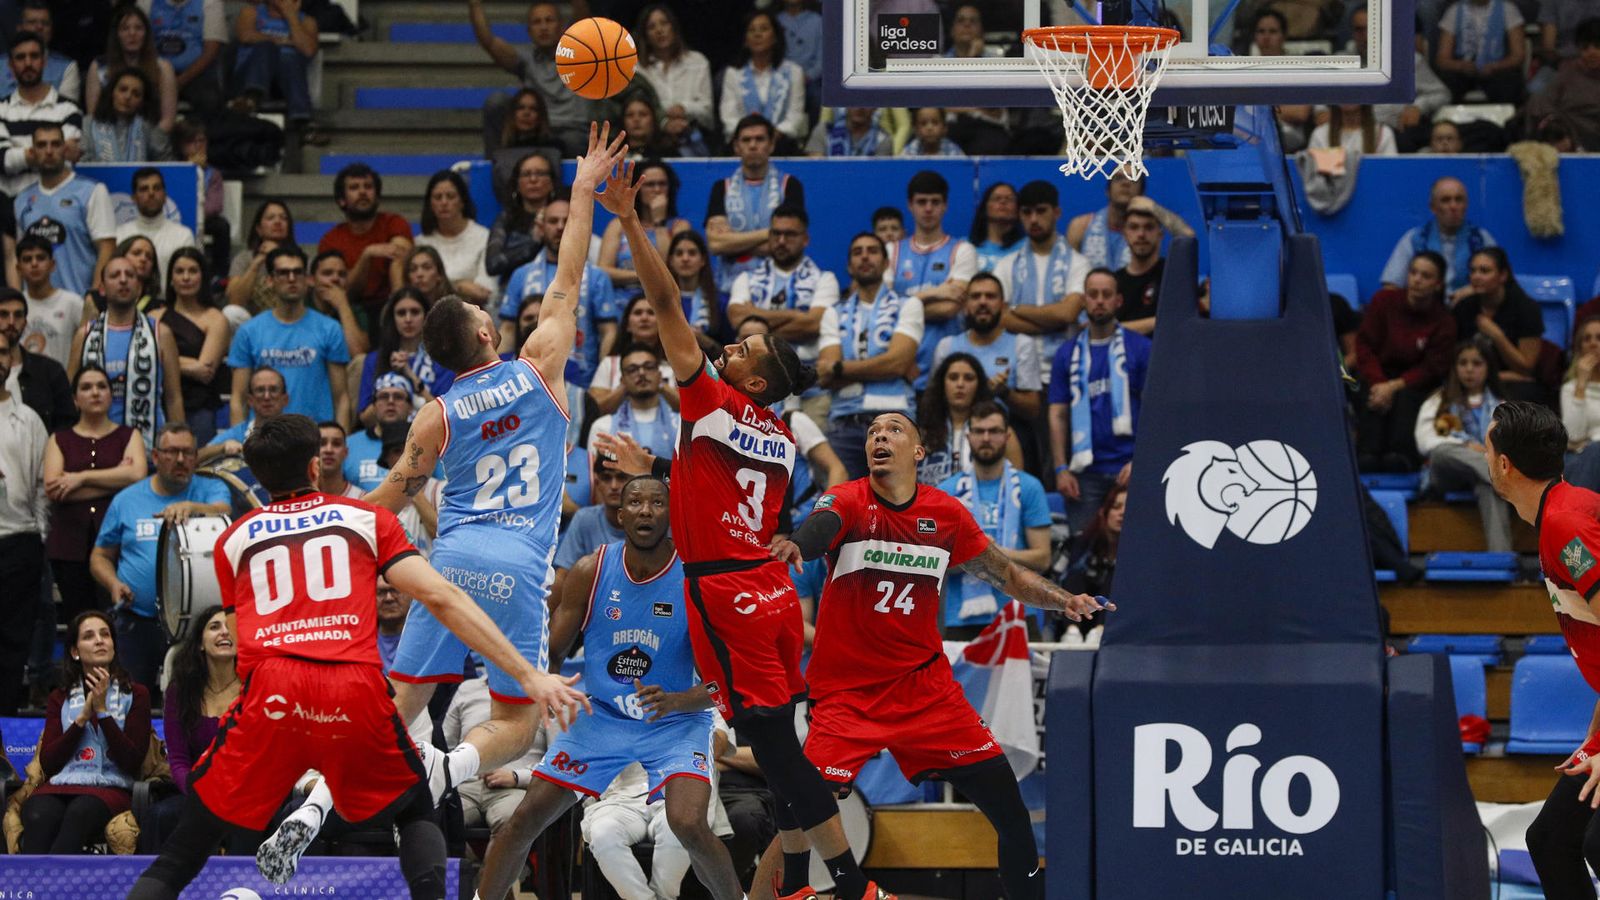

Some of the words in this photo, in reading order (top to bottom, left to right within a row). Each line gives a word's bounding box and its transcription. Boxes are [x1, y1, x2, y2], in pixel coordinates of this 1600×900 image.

[881, 25, 907, 39] liga
[881, 37, 937, 50] endesa
[453, 373, 534, 420] QUINTELA
[472, 444, 540, 510] 23
[736, 467, 767, 532] 3
[248, 509, 344, 540] PULEVA
[863, 546, 940, 570] COVIRAN
[249, 534, 352, 616] 00
[874, 580, 916, 615] 24
[255, 614, 360, 640] AYUNTAMIENTO
[262, 635, 282, 648] DE
[283, 629, 353, 645] GRANADA
[612, 629, 660, 653] BREOGÁN
[614, 664, 644, 677] Galicia
[616, 655, 648, 669] Estrella
[613, 693, 644, 720] 18
[1132, 722, 1341, 835] Río
[1176, 838, 1207, 856] DE
[1213, 838, 1304, 856] GALICIA
